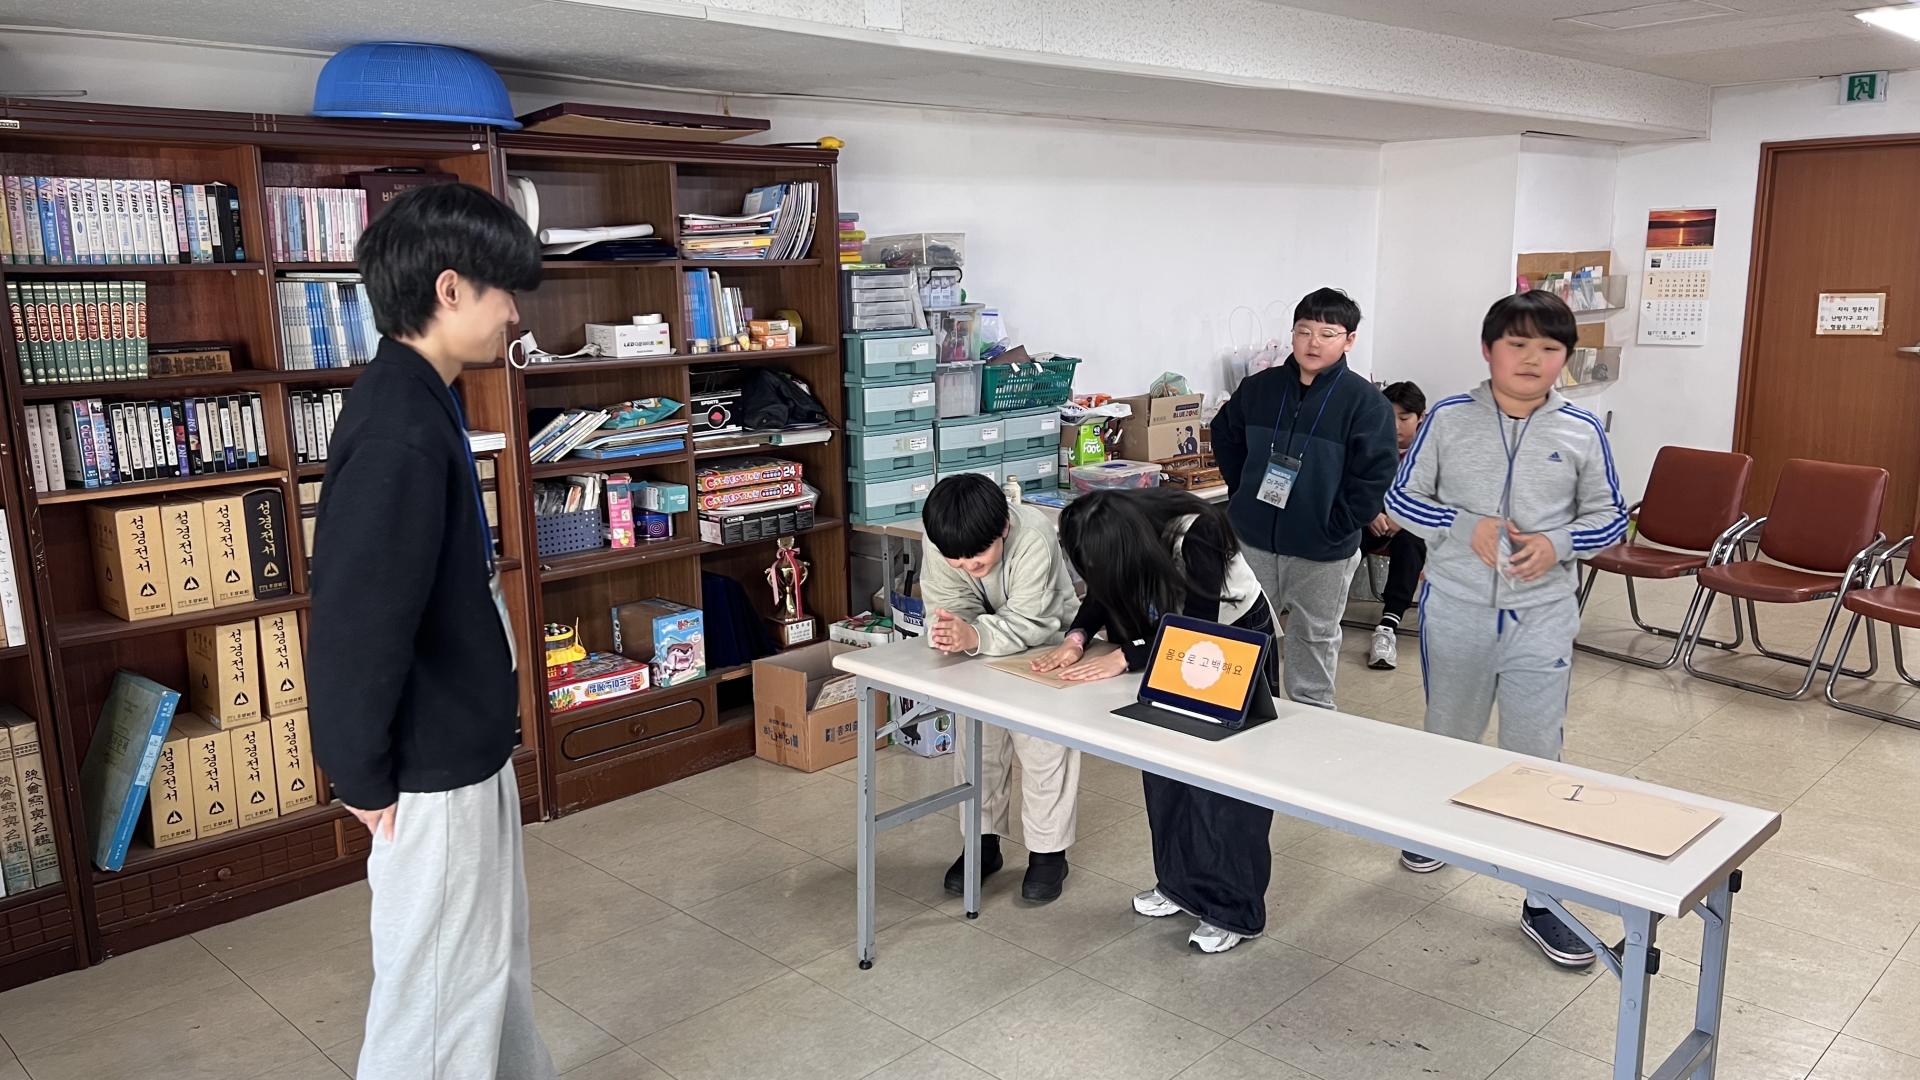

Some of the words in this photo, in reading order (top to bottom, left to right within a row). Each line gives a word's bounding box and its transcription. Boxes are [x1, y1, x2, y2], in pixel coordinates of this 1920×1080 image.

[782, 483, 795, 495] 24
[783, 465, 796, 477] 24
[130, 516, 151, 574] 성경전서
[175, 510, 195, 569] 성경전서
[216, 504, 236, 561] 성경전서
[256, 501, 277, 558] 성경전서
[230, 628, 245, 684] 성경전서
[272, 617, 290, 670] 성경전서
[1166, 648, 1196, 664] 몸으로
[1200, 657, 1243, 676] 고백해요
[203, 740, 220, 793] 성경전서
[244, 730, 261, 782] 성경전서
[284, 719, 300, 770] 성경전서
[161, 748, 178, 803] 성경전서
[1563, 784, 1584, 802] 1
